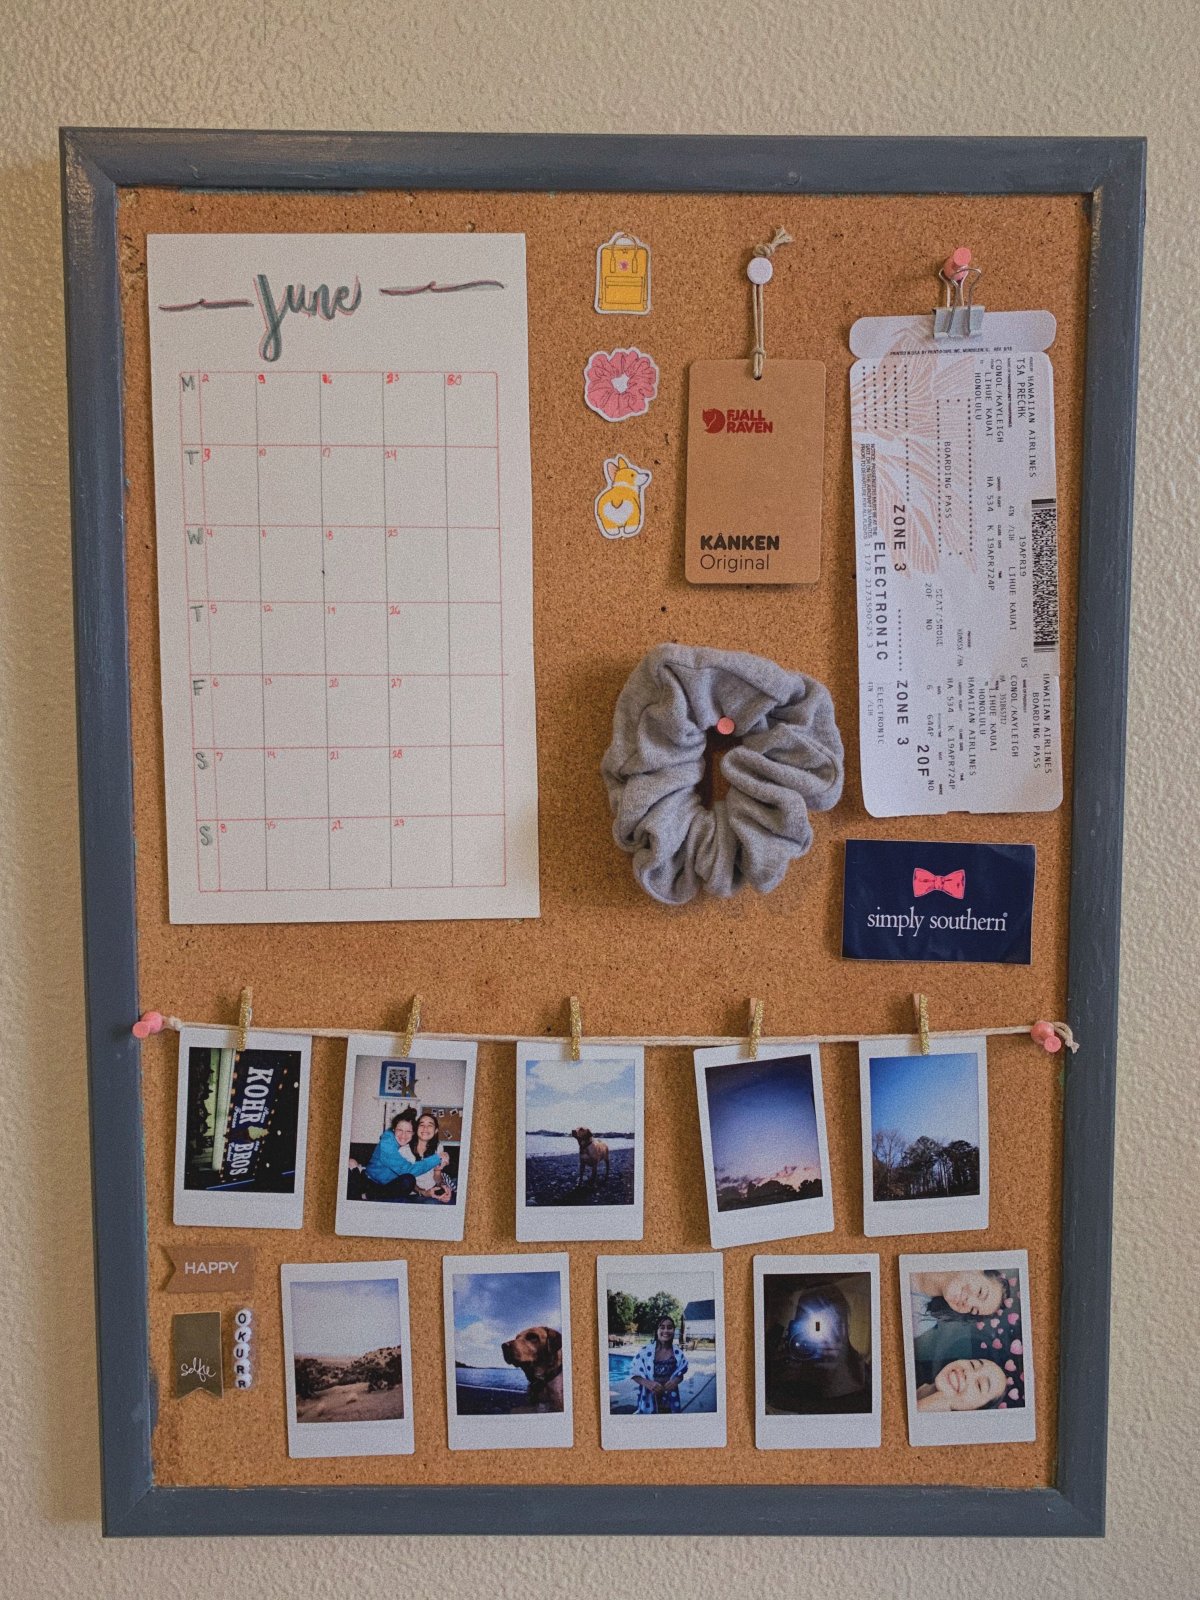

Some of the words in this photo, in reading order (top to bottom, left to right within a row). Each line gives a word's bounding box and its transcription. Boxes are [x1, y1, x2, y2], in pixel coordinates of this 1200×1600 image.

[253, 274, 362, 362] June
[1016, 358, 1025, 376] TSA
[181, 376, 196, 391] M
[201, 375, 210, 384] 2
[984, 372, 992, 401] LIHUE
[974, 372, 982, 421] HONOLULU
[995, 359, 1004, 443] CONOL/KAYLEIGH
[1017, 382, 1026, 418] PRECHK
[1027, 375, 1035, 423] HAWAIIAN
[184, 450, 199, 466] T
[385, 450, 398, 461] 24
[944, 442, 952, 489] BOARDING
[987, 476, 993, 488] HA
[186, 529, 204, 546] W
[206, 528, 214, 538] 4
[387, 528, 399, 538] 25
[893, 505, 906, 550] ZONE
[700, 532, 780, 551] KÅNKEN
[700, 554, 770, 574] Original
[894, 563, 906, 571] 3
[1019, 536, 1027, 577] 19APR19
[874, 542, 888, 660] ELECTRONIC
[190, 605, 204, 622] T
[210, 604, 218, 614] 5
[263, 604, 273, 613] 12
[926, 619, 933, 630] NO
[1021, 657, 1028, 668] US
[192, 679, 205, 696] F
[212, 679, 220, 688] 6
[391, 678, 403, 689] 27
[947, 678, 953, 689] HA
[896, 680, 908, 725] ZONE
[926, 715, 934, 737] 644P
[1032, 692, 1040, 739] BOARDING
[897, 737, 909, 745] 3
[1044, 727, 1052, 774] AIRLINES
[196, 753, 209, 770] S
[216, 752, 224, 761] 7
[330, 751, 339, 761] 21
[917, 744, 930, 777] 20F
[928, 780, 934, 791] NO
[200, 825, 213, 846] S
[867, 906, 925, 937] simply
[929, 908, 1006, 931] southern
[239, 1067, 274, 1124] KOHR
[230, 1142, 254, 1176] BROS
[184, 1261, 239, 1274] HAPPY
[234, 1312, 248, 1389] OKURR
